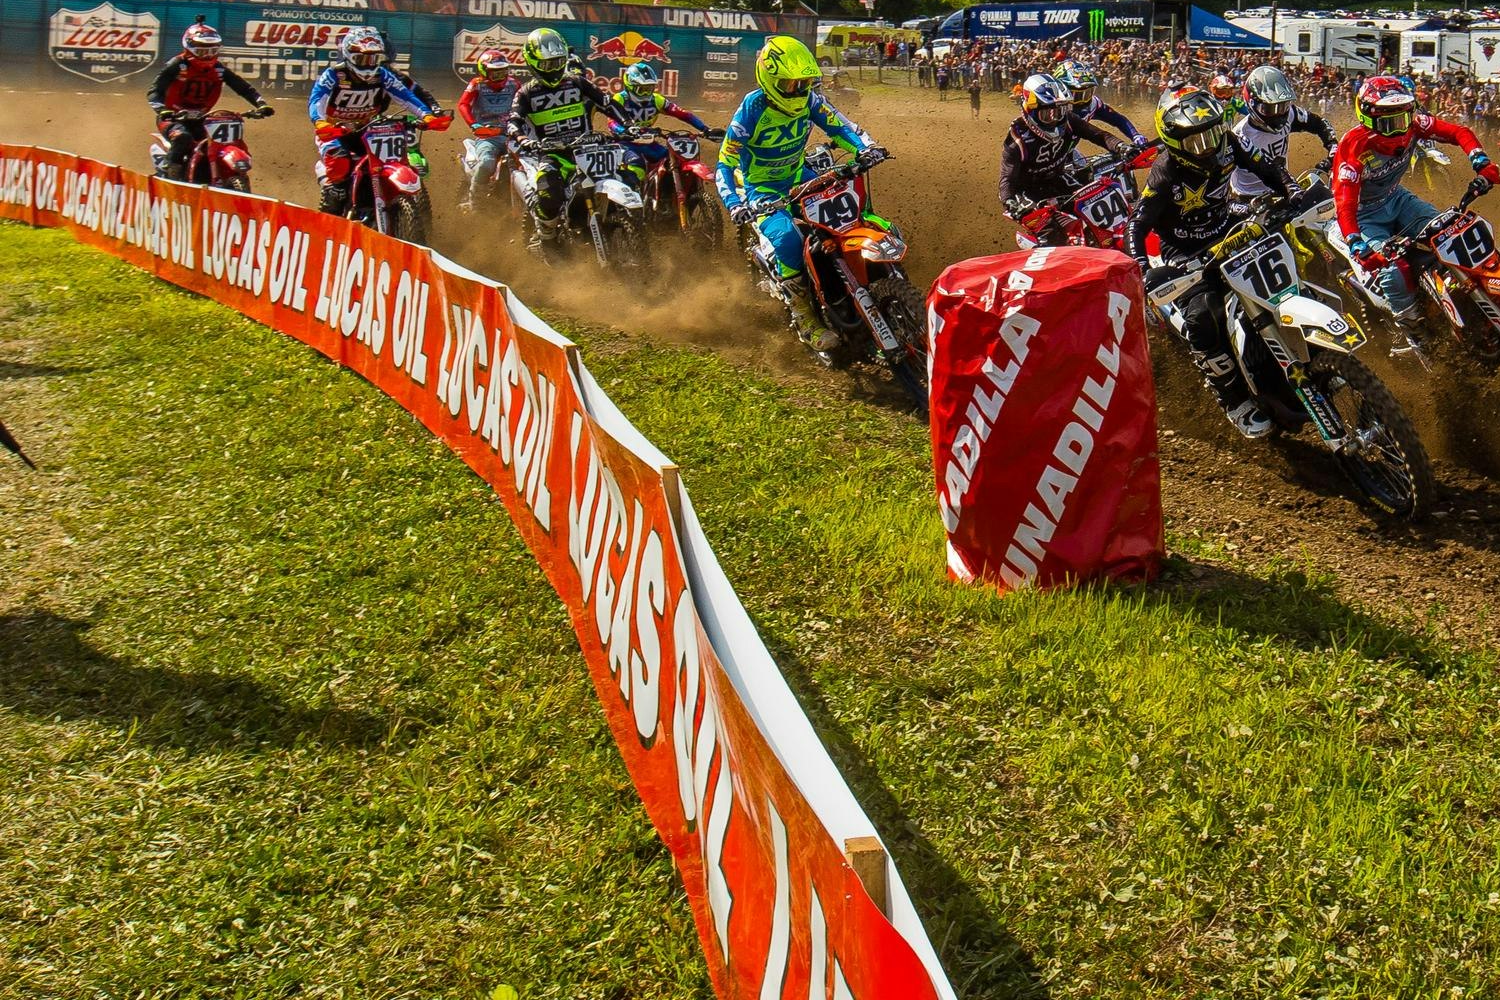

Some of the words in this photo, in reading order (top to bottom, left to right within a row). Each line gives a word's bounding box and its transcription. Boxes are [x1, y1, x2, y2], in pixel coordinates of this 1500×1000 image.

[664, 8, 758, 30] UNADILLA
[987, 11, 1012, 21] YAMAHA
[1044, 9, 1080, 24] THOR
[1105, 16, 1144, 26] MONSTER
[64, 28, 153, 49] LUCAS
[252, 23, 331, 48] LUCAS
[56, 51, 77, 60] OIL
[83, 52, 151, 63] PRODUCTS
[458, 66, 475, 75] OIL
[703, 70, 738, 80] GEICO
[334, 90, 380, 108] FOX
[531, 88, 581, 112] FXR
[212, 124, 240, 142] 41
[371, 137, 404, 160] 718
[674, 141, 698, 155] 37
[585, 151, 615, 176] 280
[818, 191, 860, 230] 49
[1090, 191, 1128, 229] 94
[1446, 220, 1495, 268] 19
[1242, 248, 1293, 301] 16
[36, 161, 58, 212] OIL
[62, 168, 101, 231] LUCAS
[101, 180, 126, 239] OIL
[126, 187, 169, 259] LUCAS
[171, 200, 195, 270] OIL
[202, 208, 271, 297] LUCAS
[268, 224, 310, 312] OIL
[315, 238, 390, 355] LUCAS
[392, 270, 430, 385] OIL
[437, 295, 519, 466] LUCAS
[512, 361, 556, 532] OIL
[568, 410, 665, 742] LUCAS
[999, 290, 1132, 591] UNADILLA
